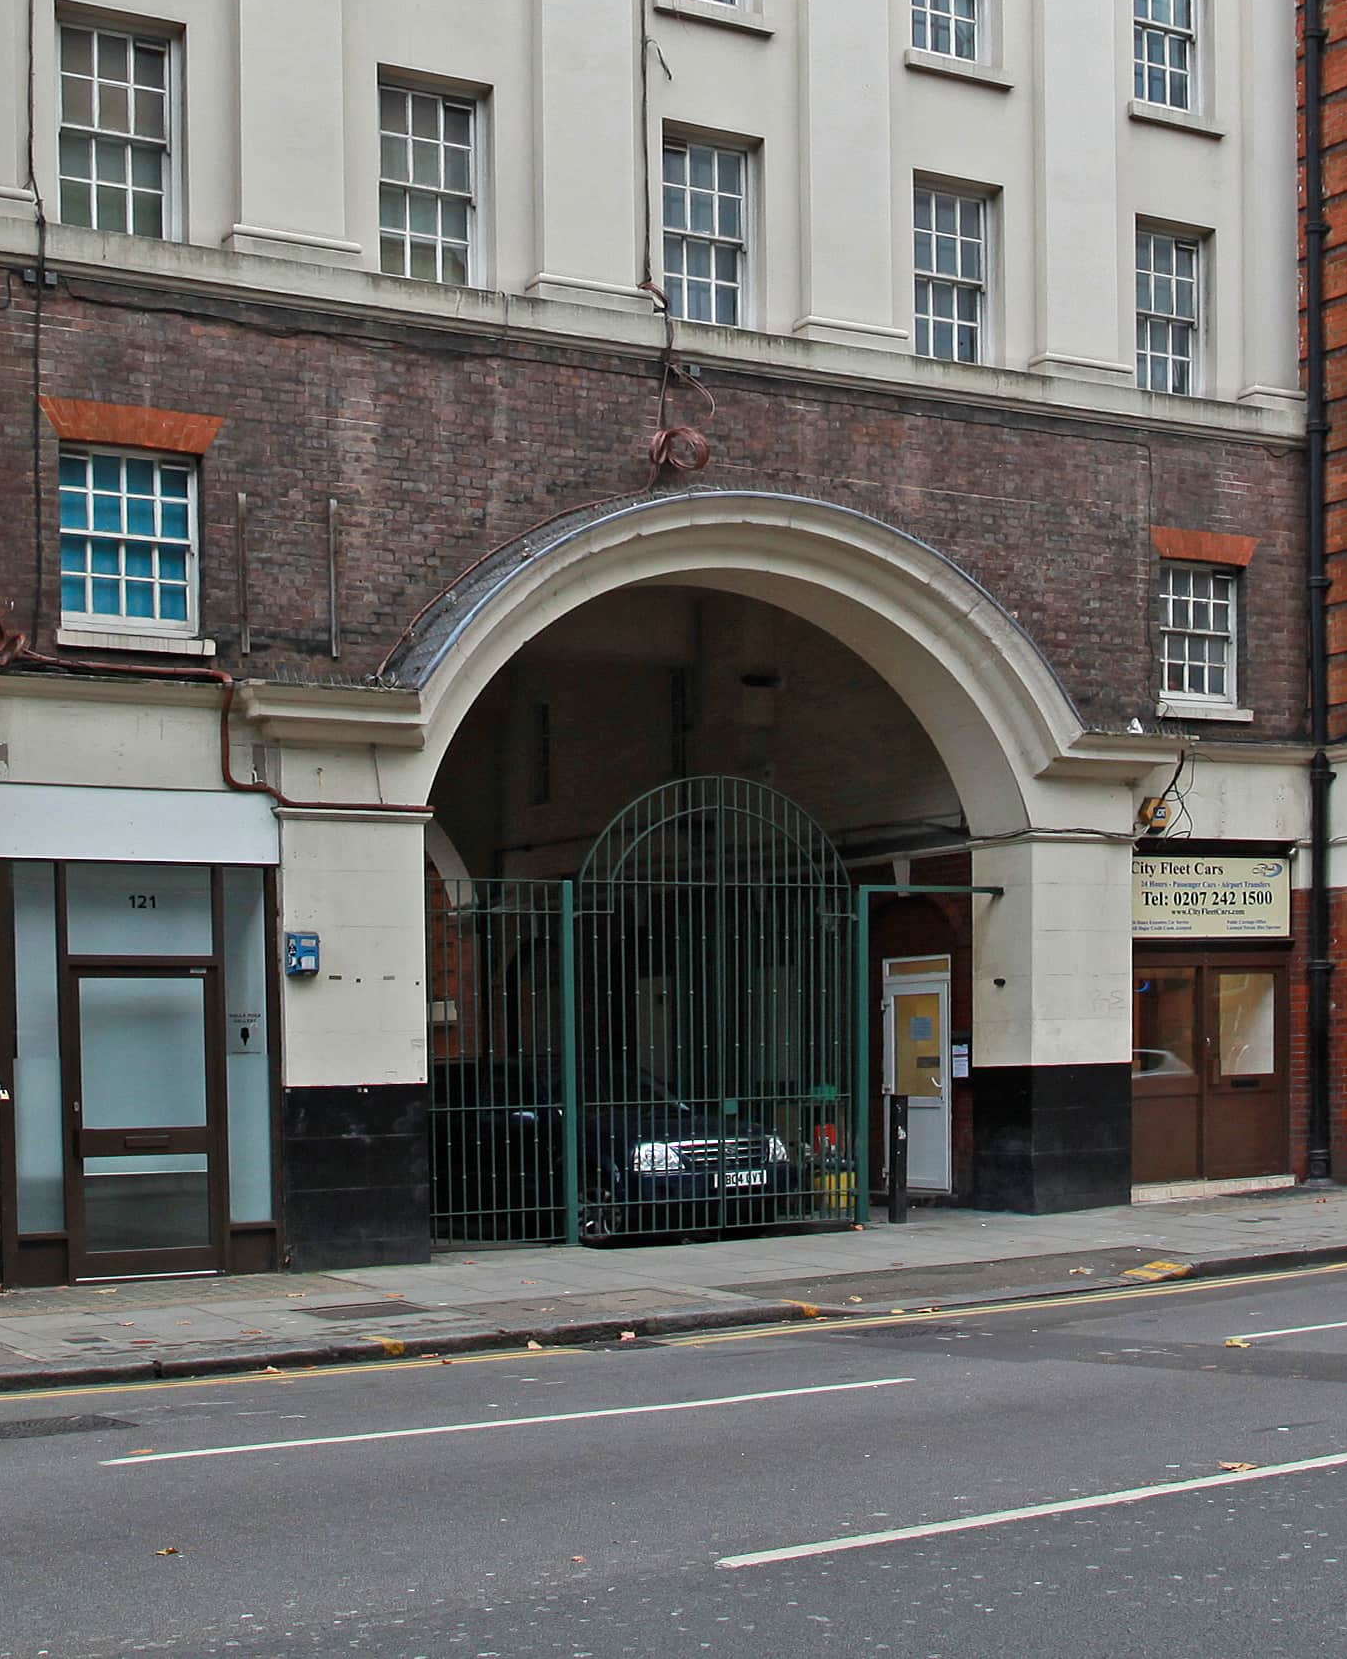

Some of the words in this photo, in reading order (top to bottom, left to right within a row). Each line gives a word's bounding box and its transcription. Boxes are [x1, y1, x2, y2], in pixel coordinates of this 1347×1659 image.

[1132, 861, 1157, 877] City
[1160, 861, 1190, 875] Fleet
[1194, 862, 1224, 875] Cars
[128, 895, 156, 908] 121
[1142, 891, 1169, 906] Tel:
[1173, 891, 1207, 906] 0207
[1212, 891, 1236, 905] 242
[1242, 891, 1272, 905] 1500
